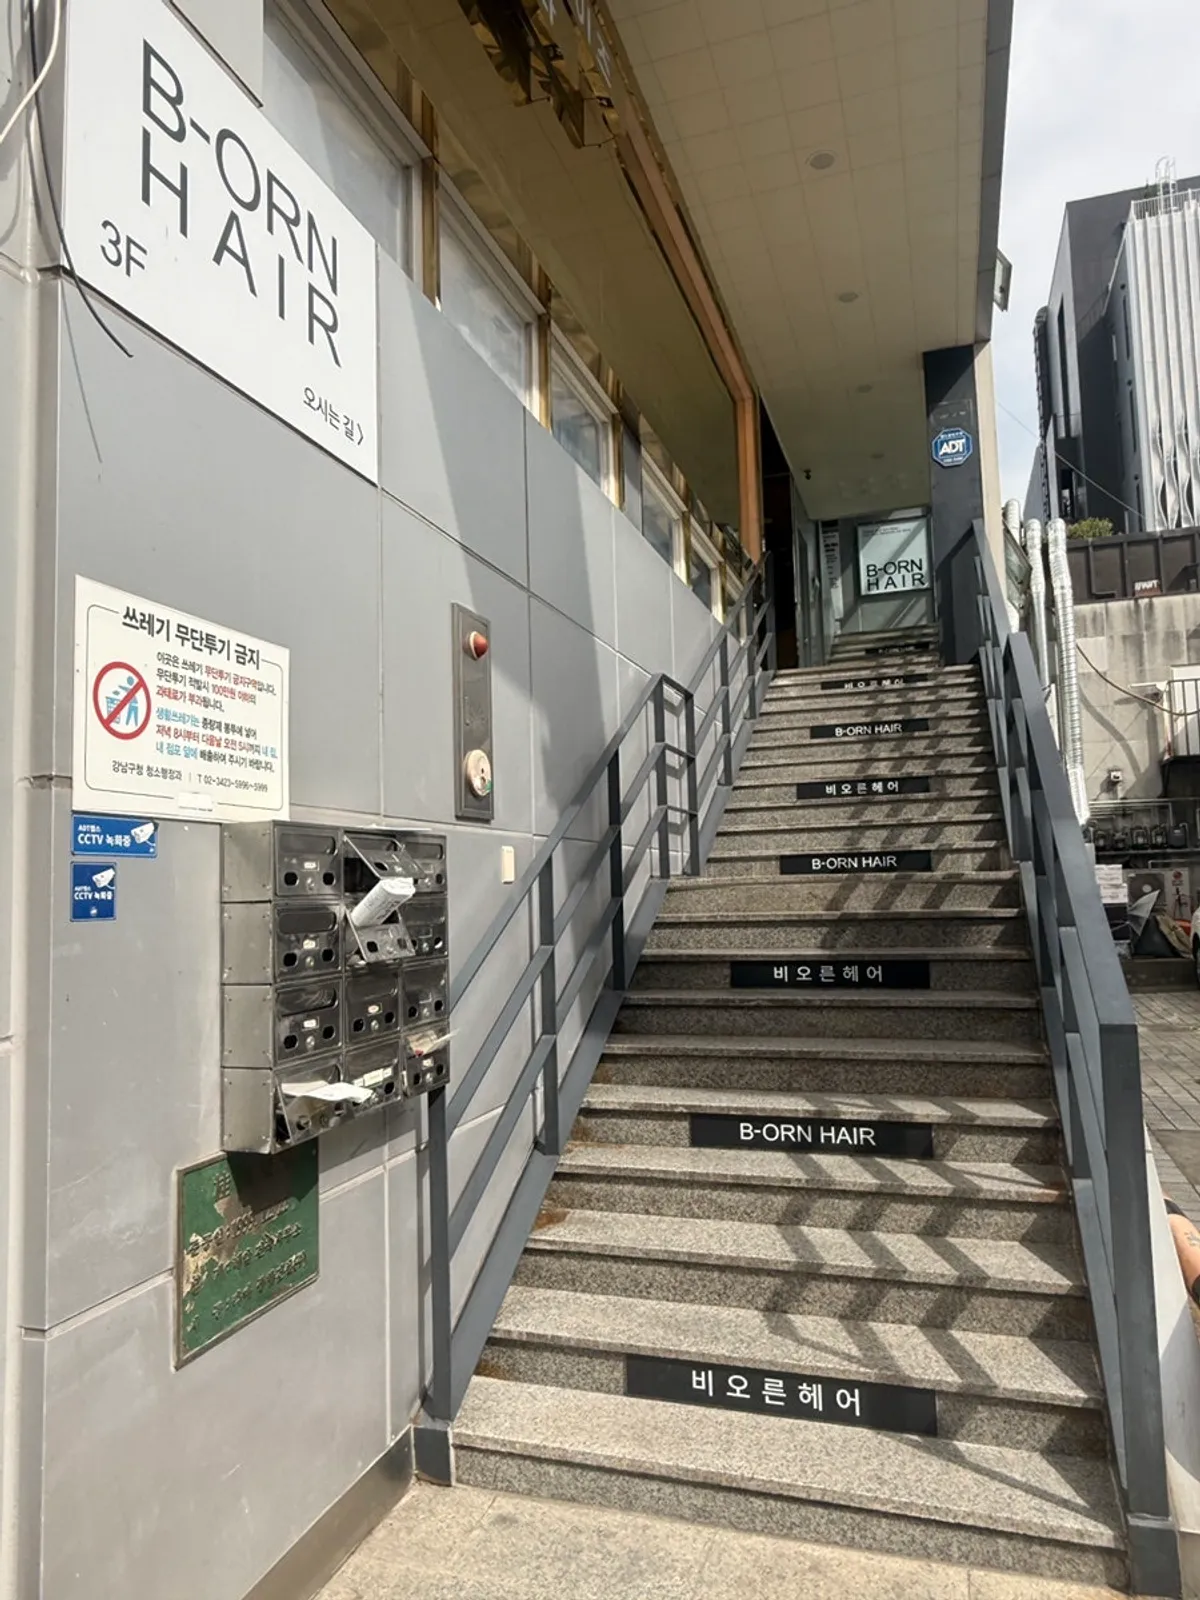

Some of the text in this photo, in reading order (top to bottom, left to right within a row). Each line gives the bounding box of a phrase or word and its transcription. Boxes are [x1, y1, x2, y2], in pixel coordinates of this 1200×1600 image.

[142, 38, 338, 296] B-ORN
[100, 220, 147, 282] 3F
[141, 126, 342, 367] HAIR
[939, 438, 965, 456] ADT
[866, 558, 923, 578] B-ORN
[866, 572, 926, 592] HAIR
[122, 606, 260, 670] 쓰레기 무단투기 금지
[156, 668, 186, 687] 무단투기
[181, 659, 203, 675] 쓰레기
[204, 665, 232, 683] 무단투기
[834, 722, 903, 738] B-ORN HAIR
[112, 760, 144, 776] 강남구청
[78, 834, 104, 844] CCTV
[812, 855, 898, 870] B-ORN HAIR
[74, 892, 92, 900] CCTV
[739, 1122, 876, 1147] B-ORN HAIR
